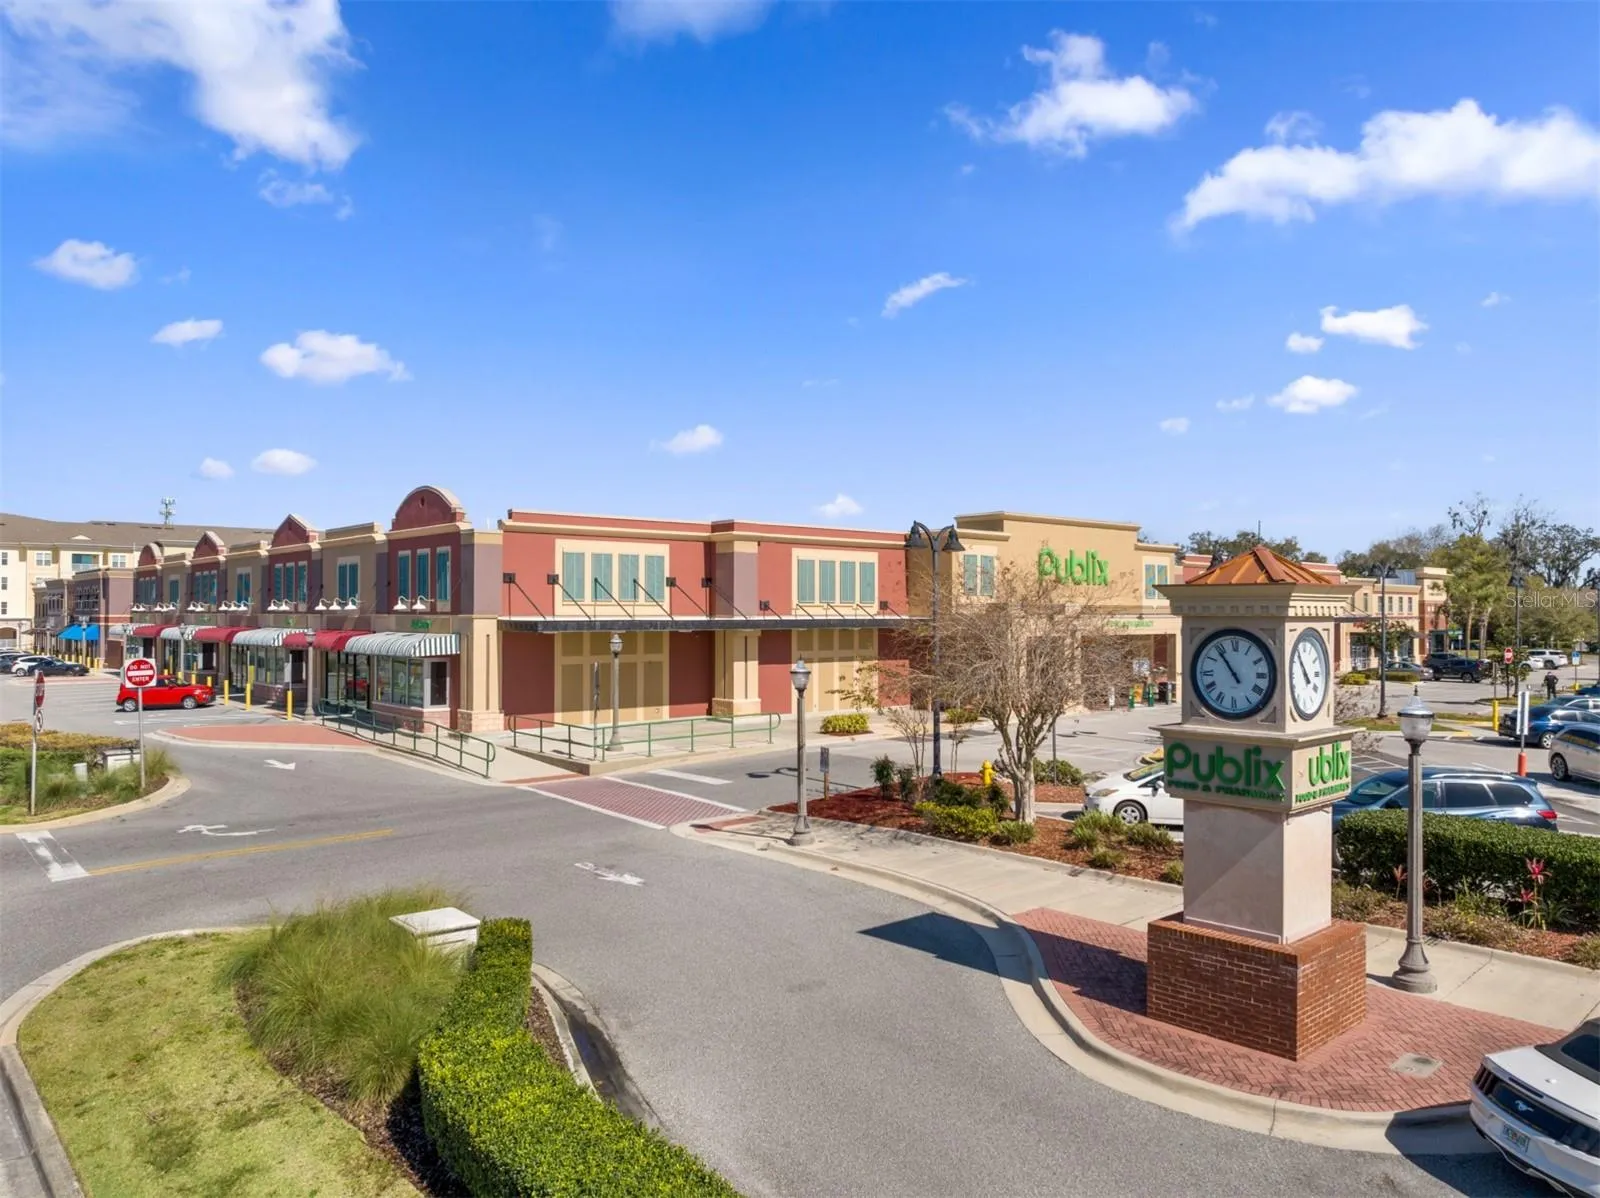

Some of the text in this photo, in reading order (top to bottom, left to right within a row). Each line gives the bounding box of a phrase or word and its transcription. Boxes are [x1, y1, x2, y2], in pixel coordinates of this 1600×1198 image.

[1037, 548, 1109, 586] Publix
[1166, 742, 1286, 790] Publix
[1308, 740, 1349, 786] ublix
